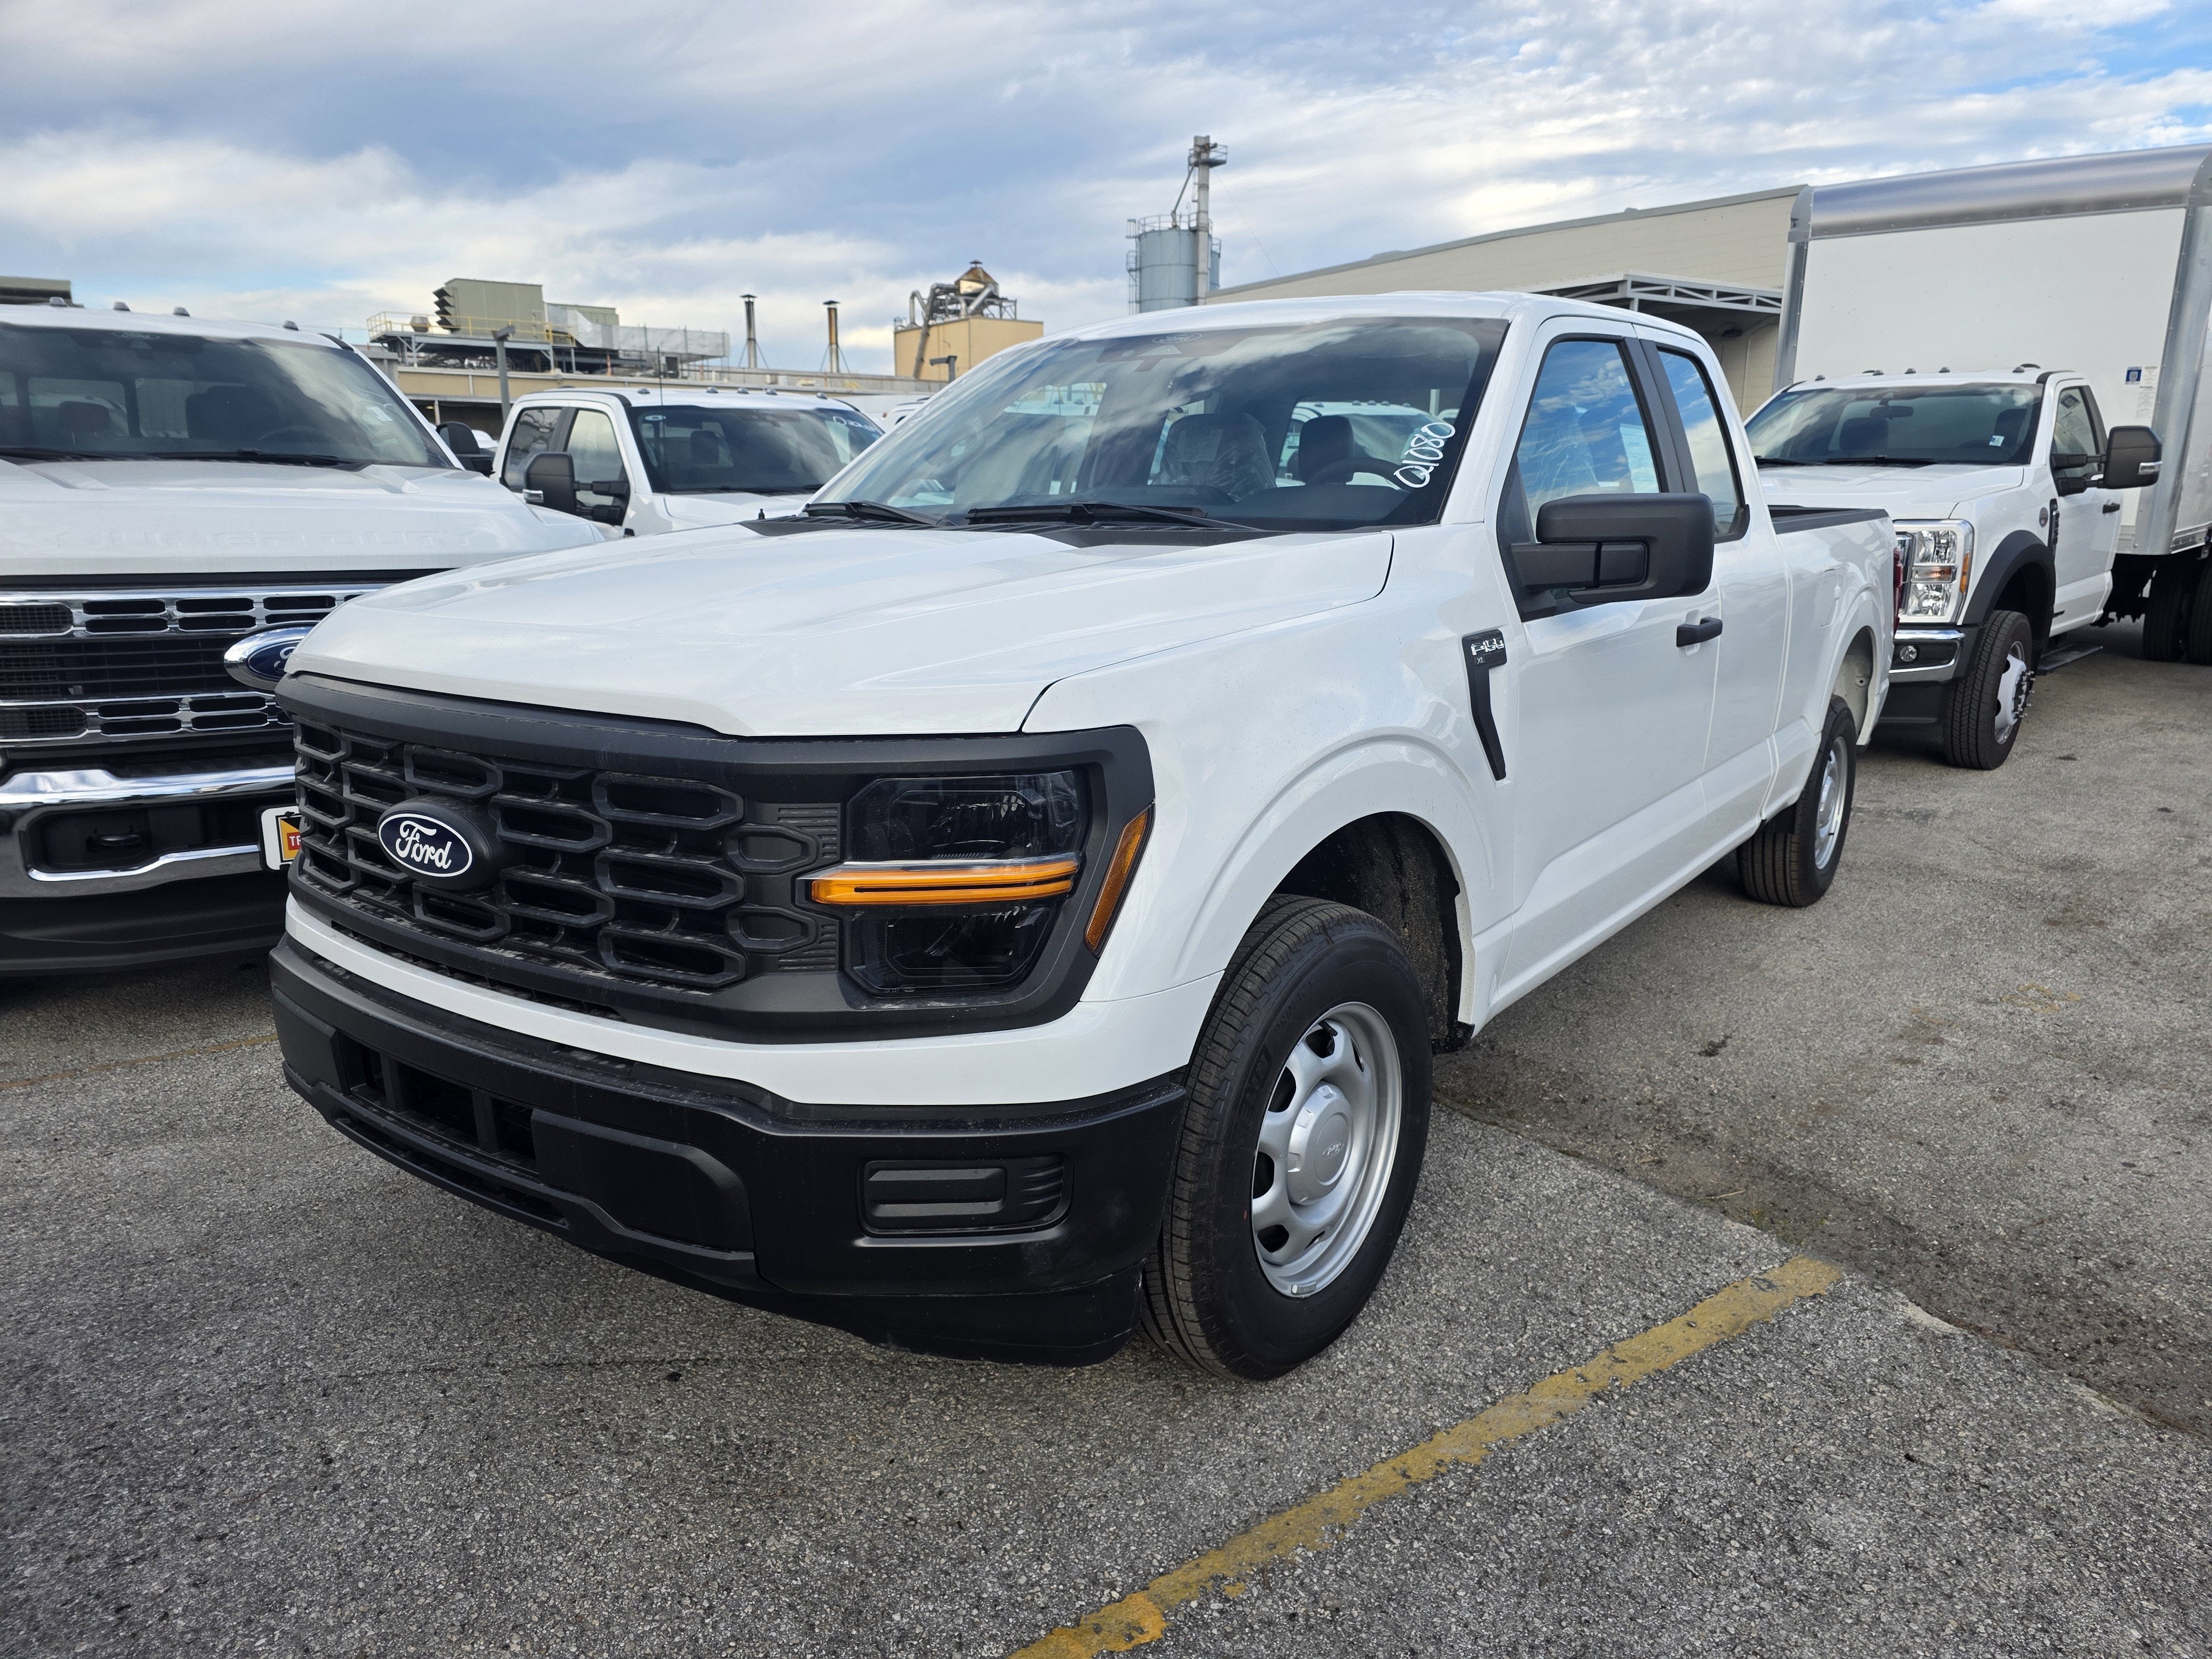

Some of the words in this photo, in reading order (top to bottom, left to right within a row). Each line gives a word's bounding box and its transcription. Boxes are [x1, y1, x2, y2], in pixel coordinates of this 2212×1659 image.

[1394, 422, 1455, 488] Q1080
[1476, 656, 1485, 665] XL
[395, 820, 452, 869] Ford
